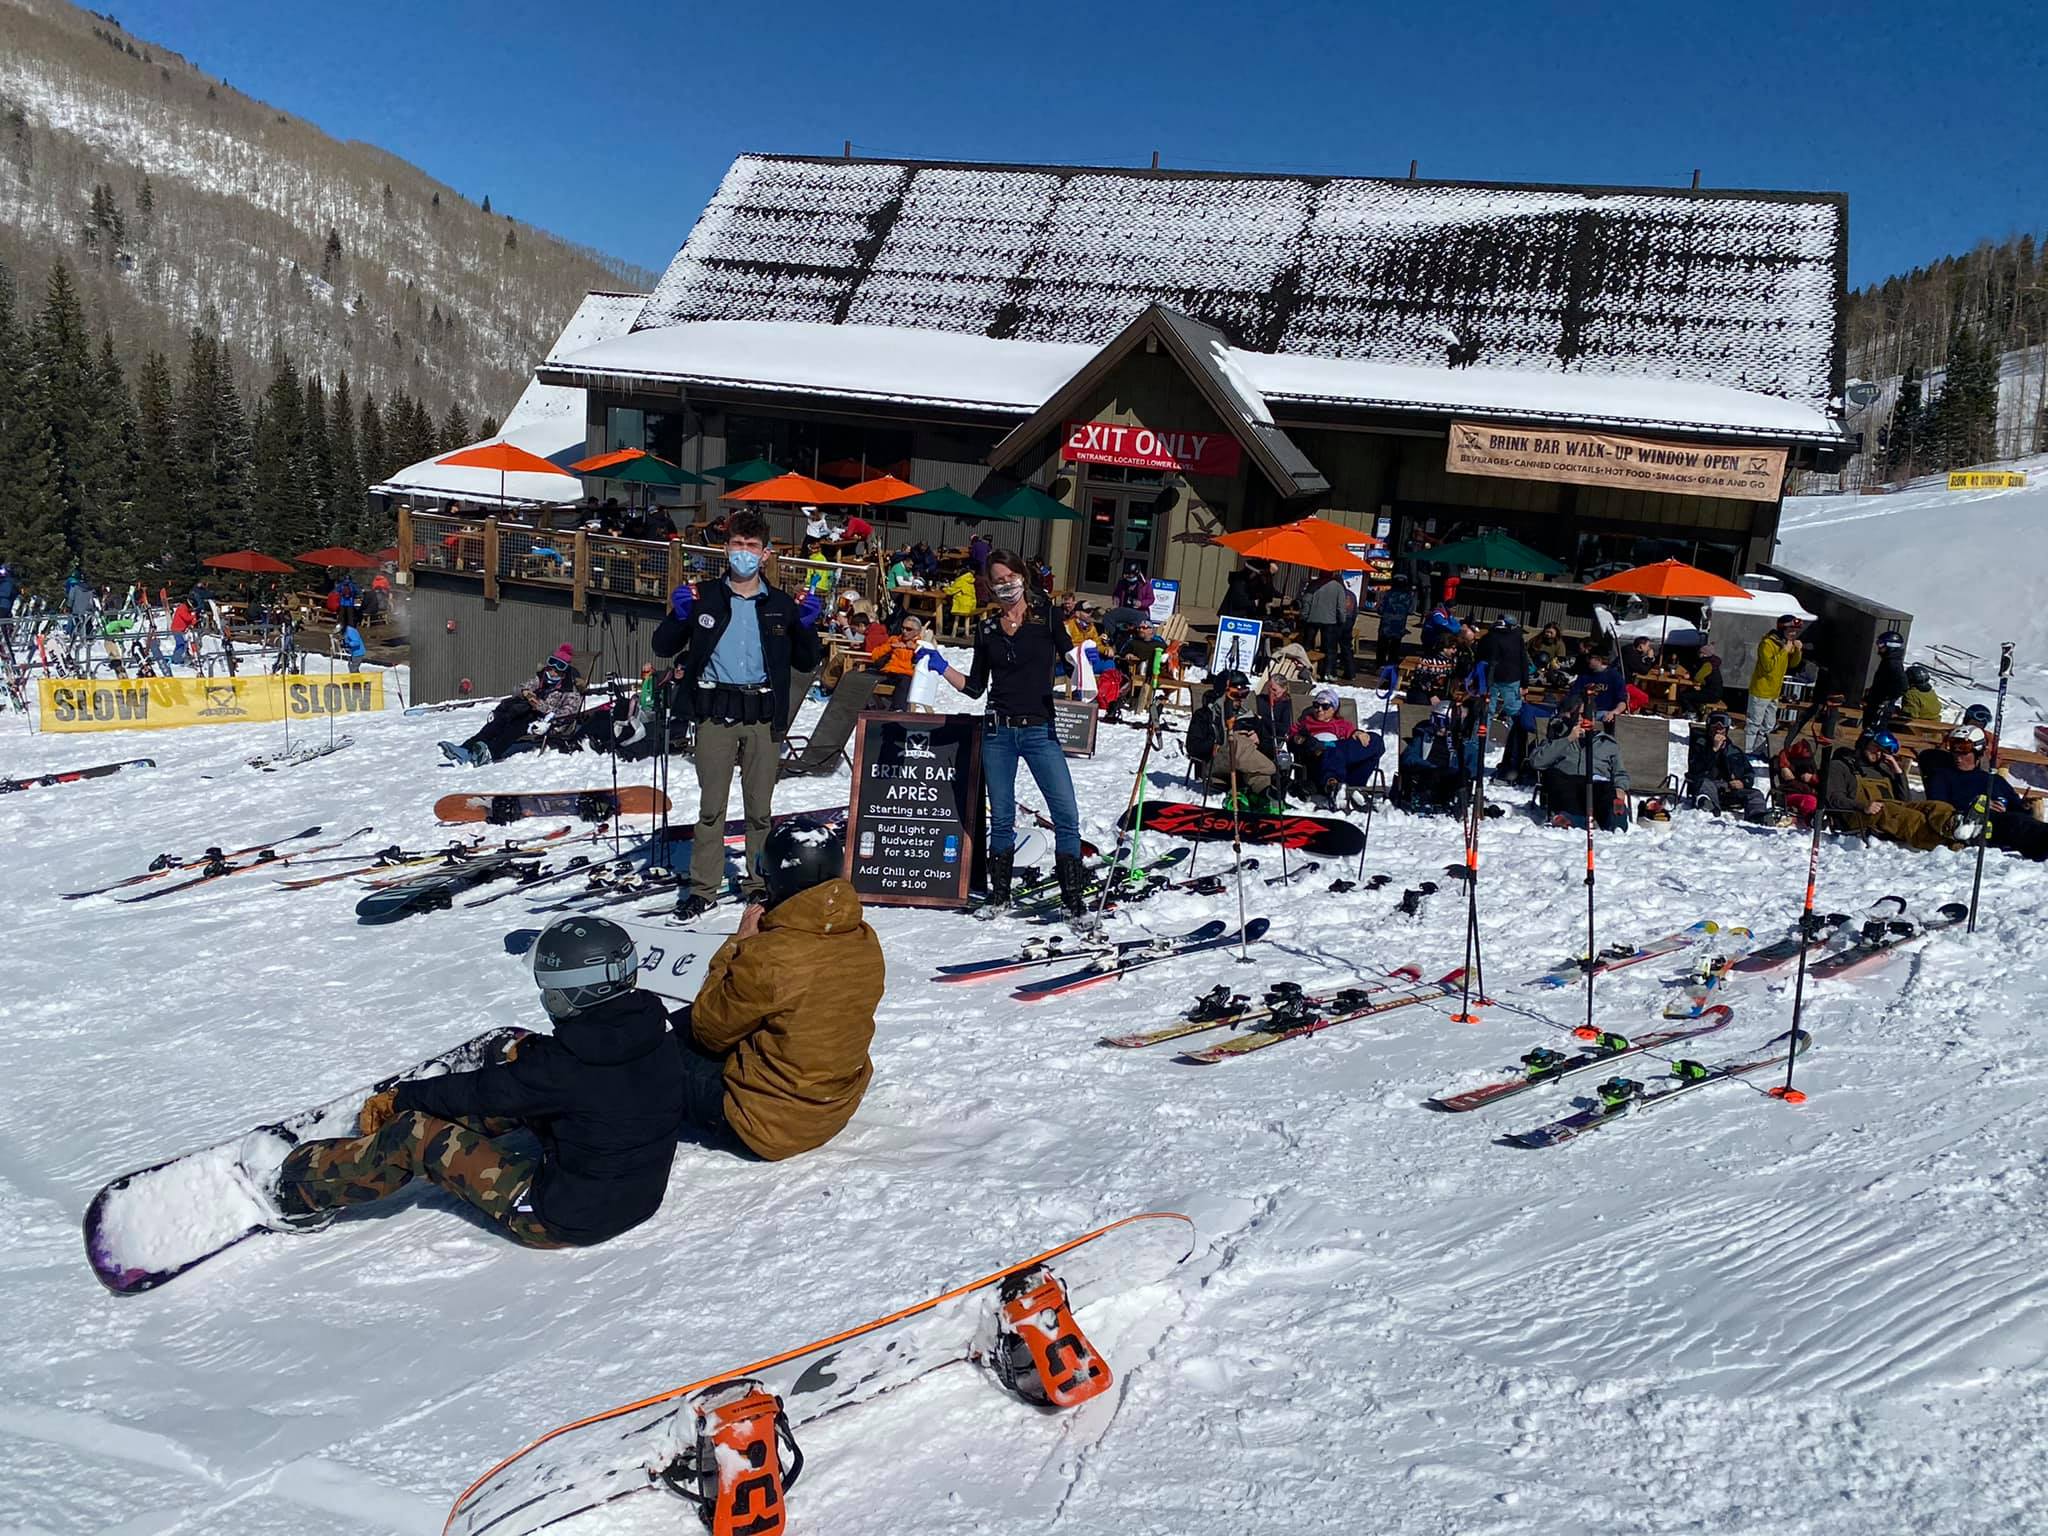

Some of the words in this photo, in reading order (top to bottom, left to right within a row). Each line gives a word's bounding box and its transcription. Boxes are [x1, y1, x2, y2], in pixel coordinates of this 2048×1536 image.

[1068, 424, 1128, 452] EXIT
[1135, 430, 1208, 460] ONLY
[1076, 452, 1113, 463] ENTRANCE
[1113, 456, 1145, 466] LOCATED
[1146, 459, 1172, 468] LOWER
[1489, 434, 1530, 451] BRINK
[1534, 438, 1561, 455] BAR
[1566, 440, 1633, 461] WALK-UP
[1638, 447, 1700, 467] WINDOW
[1703, 454, 1740, 471] OPEN
[1514, 458, 1551, 470] CANNED
[1553, 462, 1601, 474] COCKTAILS
[1604, 466, 1623, 476] HOT
[1625, 469, 1651, 478] FOOD
[1655, 472, 1693, 483] SNACKS
[1697, 476, 1724, 486] GRAB
[1726, 479, 1748, 488] AND
[1749, 480, 1765, 489] GO
[53, 687, 149, 722] SLOW
[289, 681, 372, 715] SLOW
[871, 763, 918, 779] BRINK
[925, 766, 956, 781] BAR
[886, 781, 938, 801] APRÈS
[869, 804, 913, 817] Starting
[916, 807, 929, 816] at
[931, 807, 952, 817] 2:30
[878, 823, 896, 833] Bud
[899, 824, 926, 836] Light
[881, 835, 935, 847] Budweiser
[884, 847, 900, 857] for
[903, 848, 930, 858] $3.50
[859, 865, 880, 875] Add
[908, 869, 920, 877] or
[923, 868, 952, 880] Chips
[881, 878, 898, 888] for
[901, 879, 927, 889] $1.00
